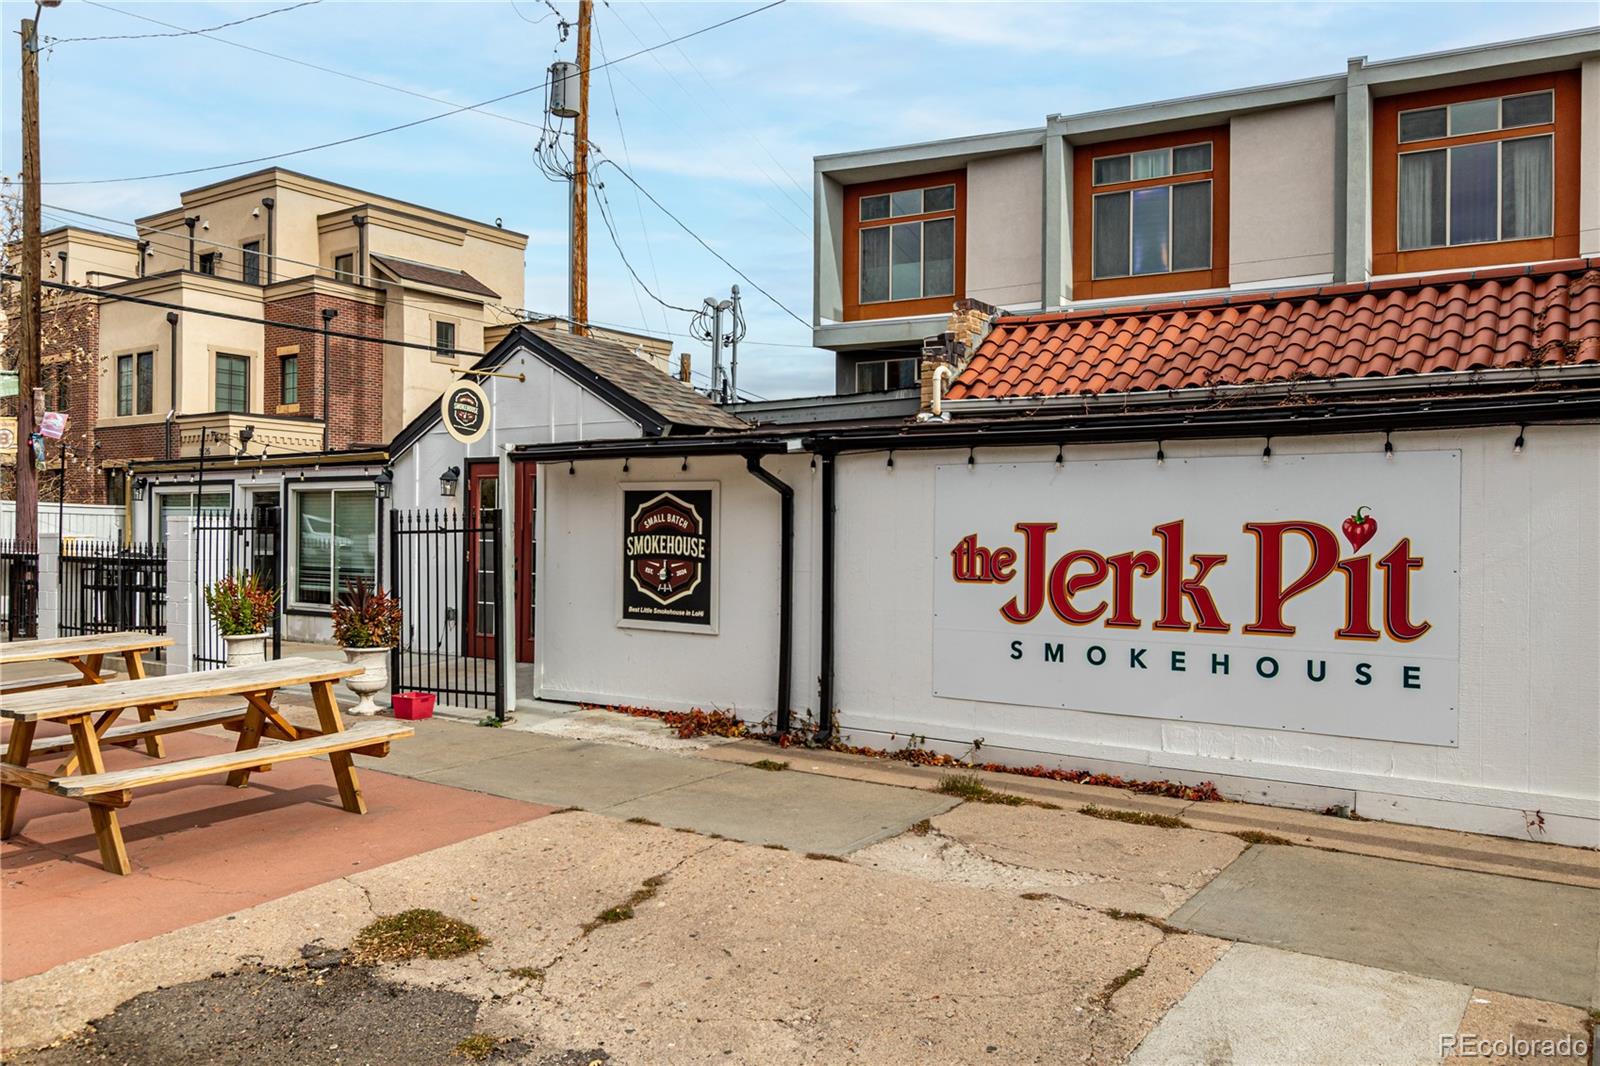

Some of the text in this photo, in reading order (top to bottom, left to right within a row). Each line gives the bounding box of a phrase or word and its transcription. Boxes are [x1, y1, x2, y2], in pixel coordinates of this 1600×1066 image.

[643, 513, 689, 529] SMALL BATCH
[626, 535, 706, 559] SMOKEHOUSE
[951, 506, 1431, 643] the Jerk Pit
[640, 606, 653, 614] Little
[653, 607, 685, 616] Smokehouse
[1010, 641, 1421, 689] SMOKEHOUSE
